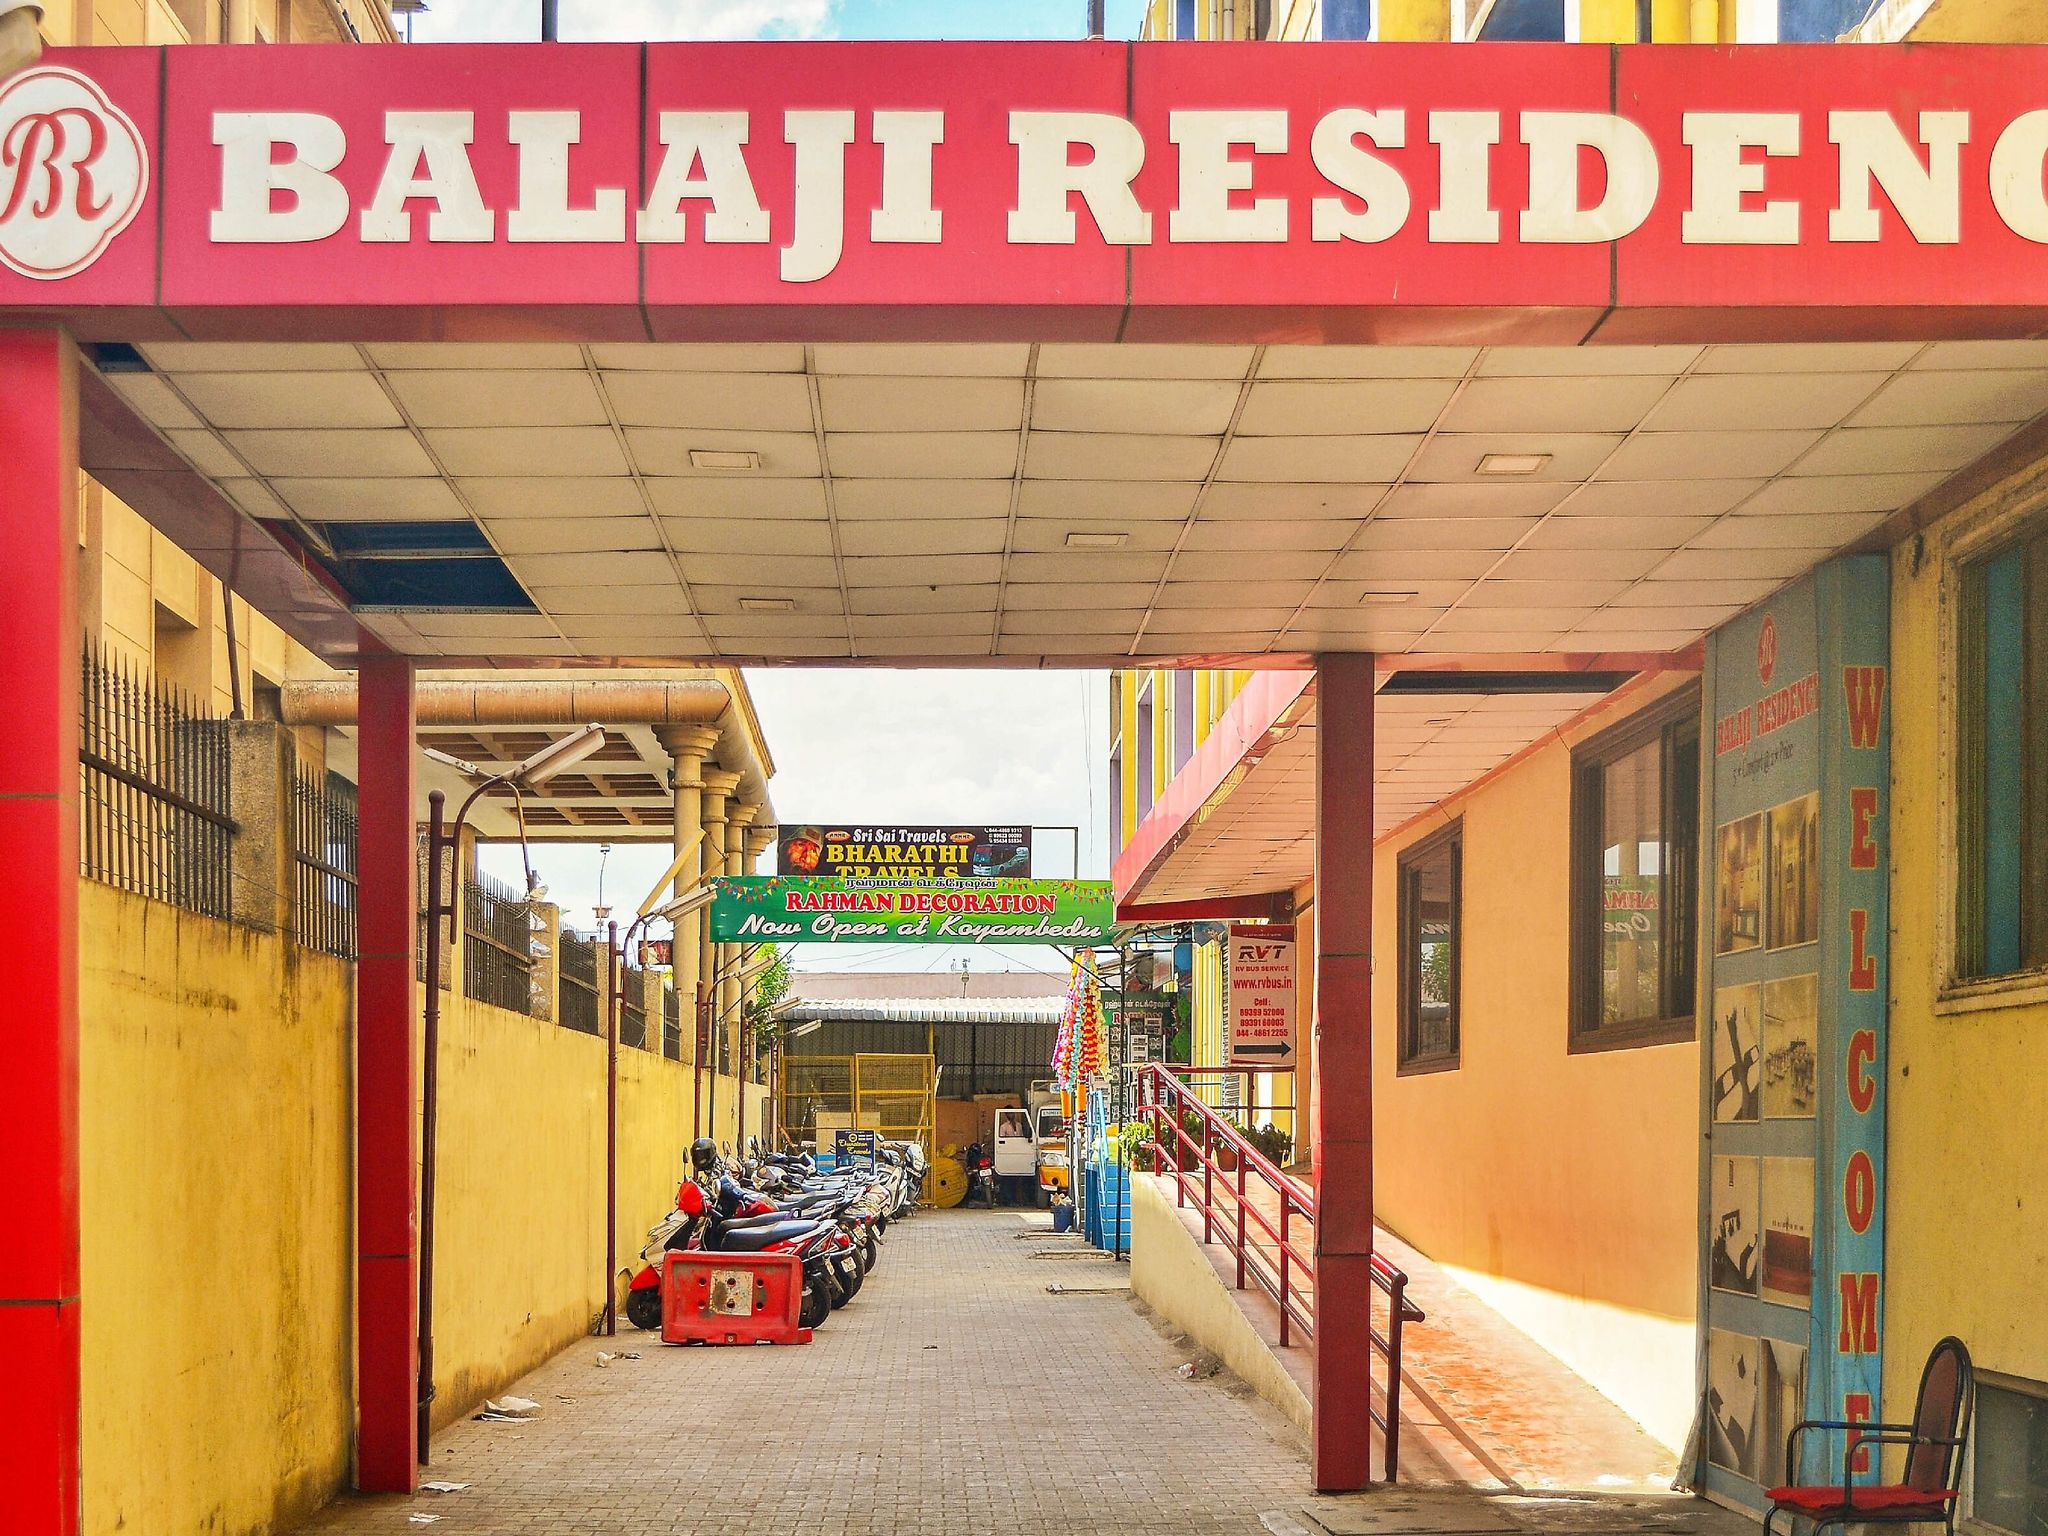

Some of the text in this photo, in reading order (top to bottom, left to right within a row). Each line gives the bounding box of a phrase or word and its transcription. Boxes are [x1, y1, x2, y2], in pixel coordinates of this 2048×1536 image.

[209, 109, 945, 282] BALAJI
[853, 828, 947, 843] Sri Sai Travels
[826, 844, 968, 863] BHARATHI
[786, 892, 1056, 914] RAHMAN DECORATION
[737, 913, 1102, 943] Now Open at Koyambedu
[1238, 944, 1287, 960] RVT
[1233, 976, 1292, 989] www.rvbus.in
[1838, 665, 1886, 1474] WELCOME
